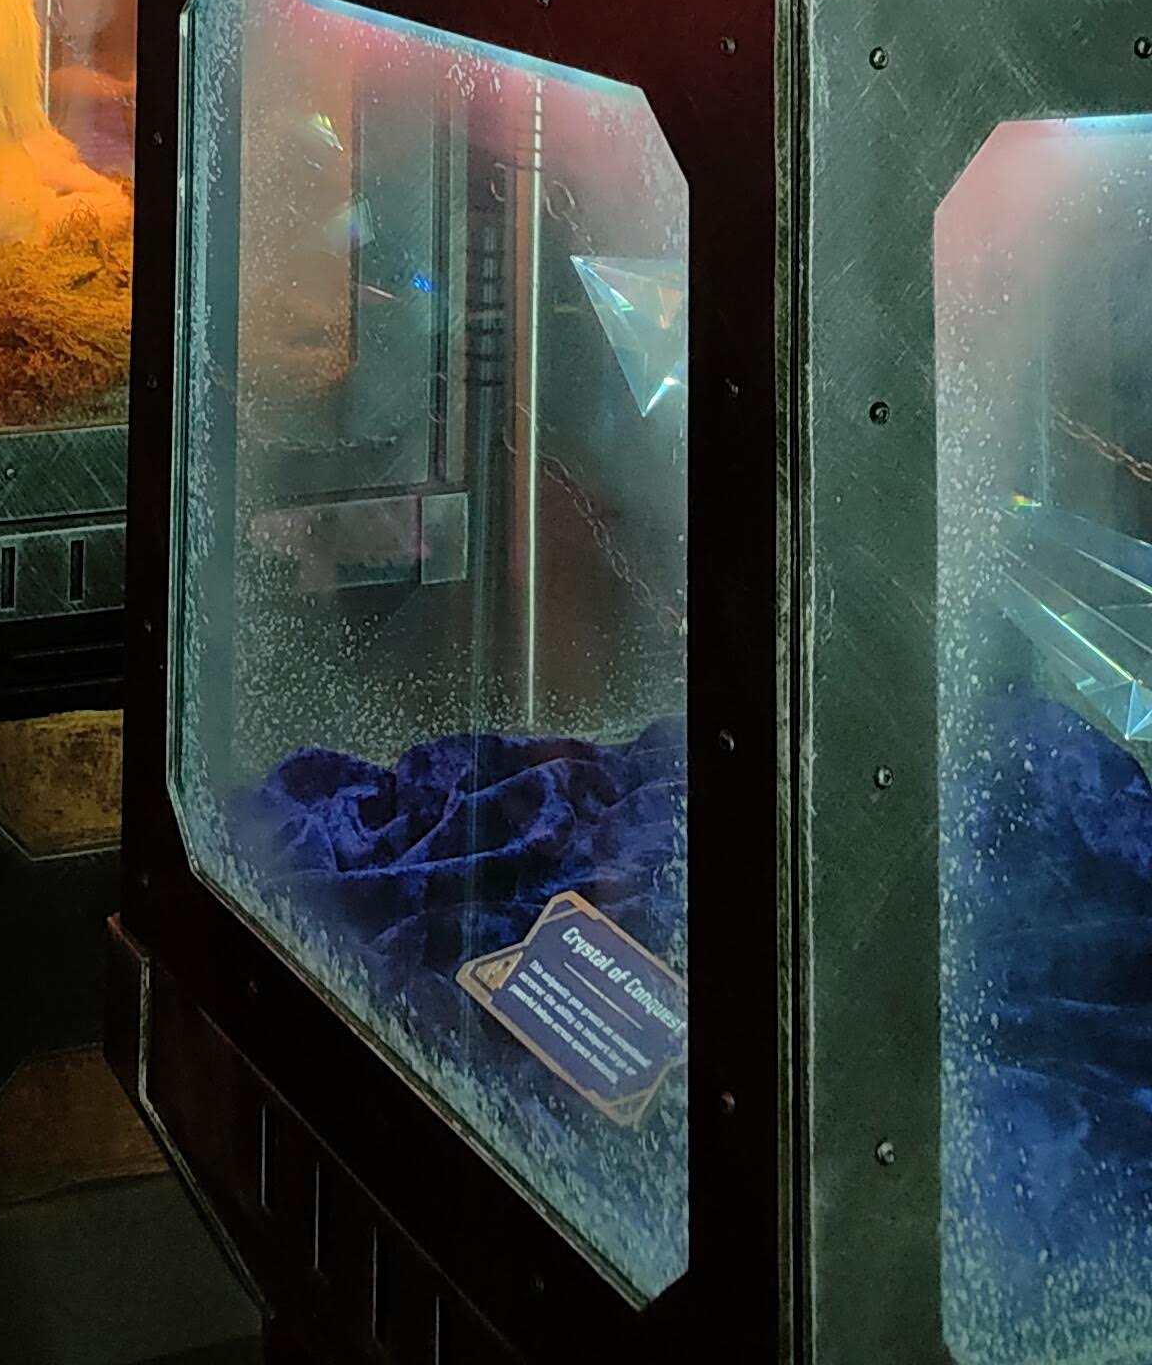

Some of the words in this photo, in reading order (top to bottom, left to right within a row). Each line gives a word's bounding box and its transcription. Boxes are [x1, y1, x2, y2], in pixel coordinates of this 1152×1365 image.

[562, 927, 615, 971] Crystal
[608, 967, 631, 983] of
[624, 977, 687, 1034] Conquest
